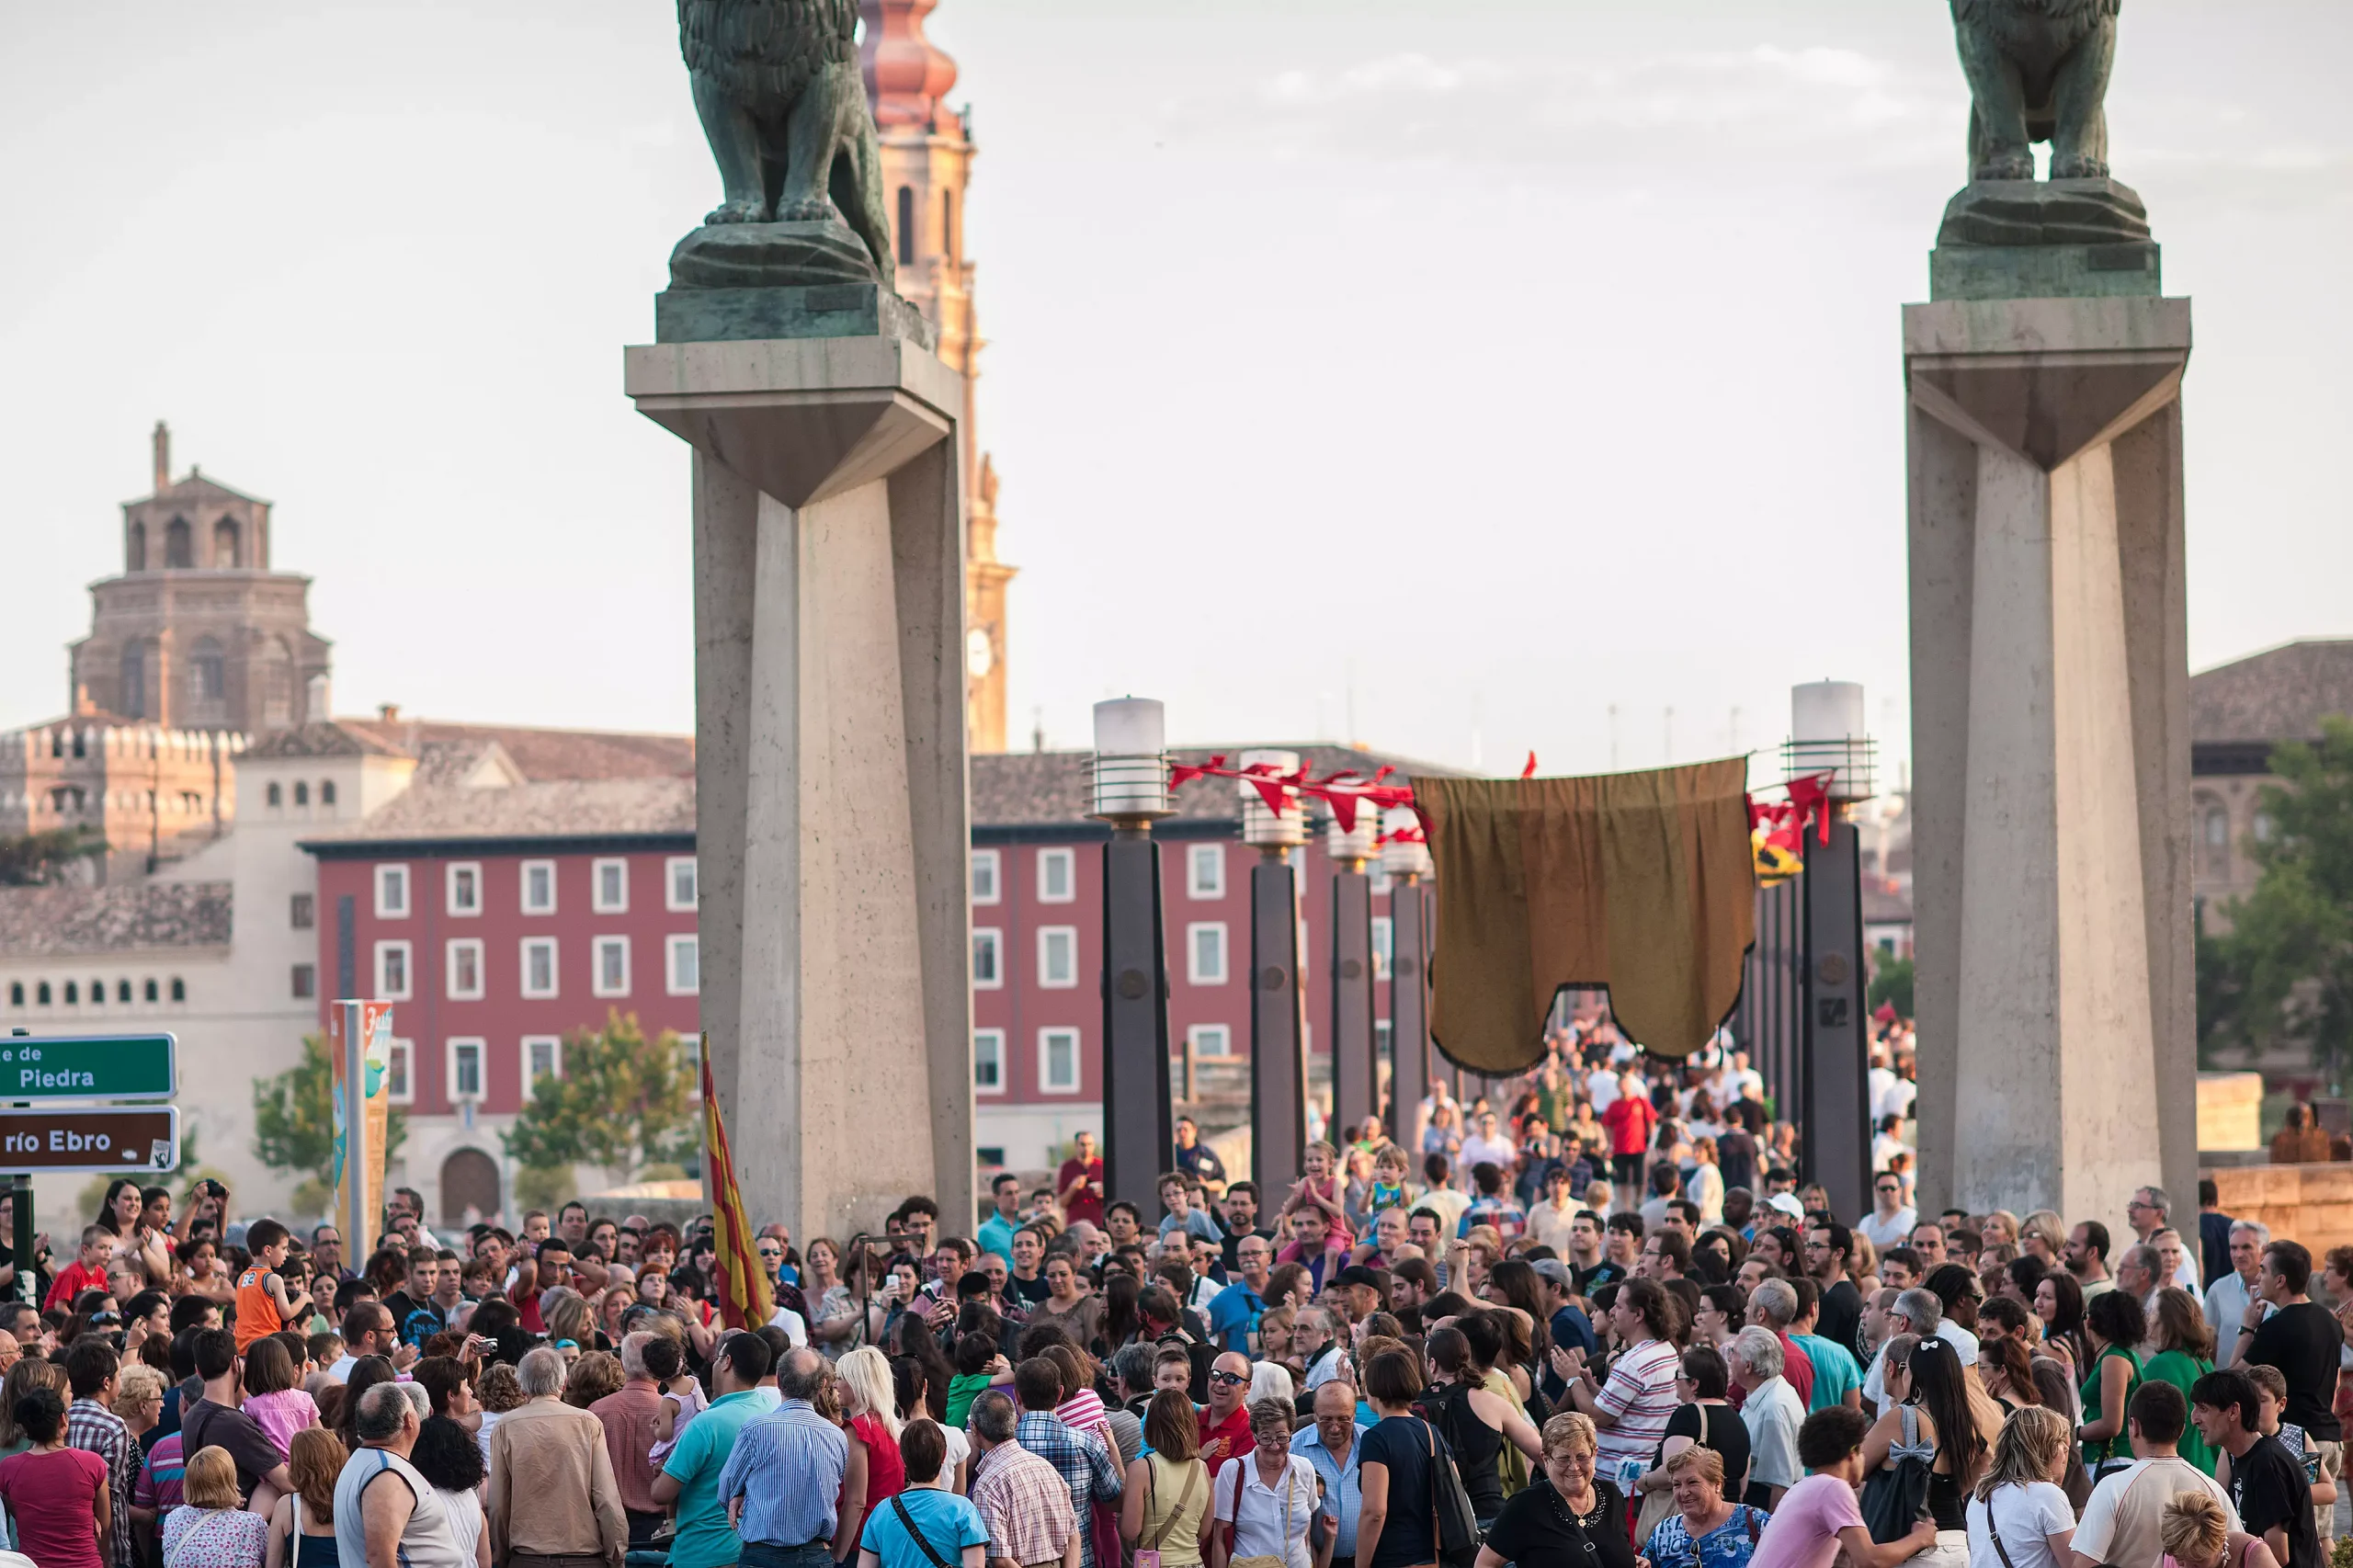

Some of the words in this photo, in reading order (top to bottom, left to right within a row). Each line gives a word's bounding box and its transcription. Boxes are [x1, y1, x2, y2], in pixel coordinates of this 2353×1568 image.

[0, 1050, 13, 1062] e
[19, 1046, 42, 1061] de
[20, 1068, 95, 1088] Piedra
[6, 1131, 40, 1153] río
[49, 1130, 111, 1153] Ebro
[910, 1526, 929, 1550] TOUS
